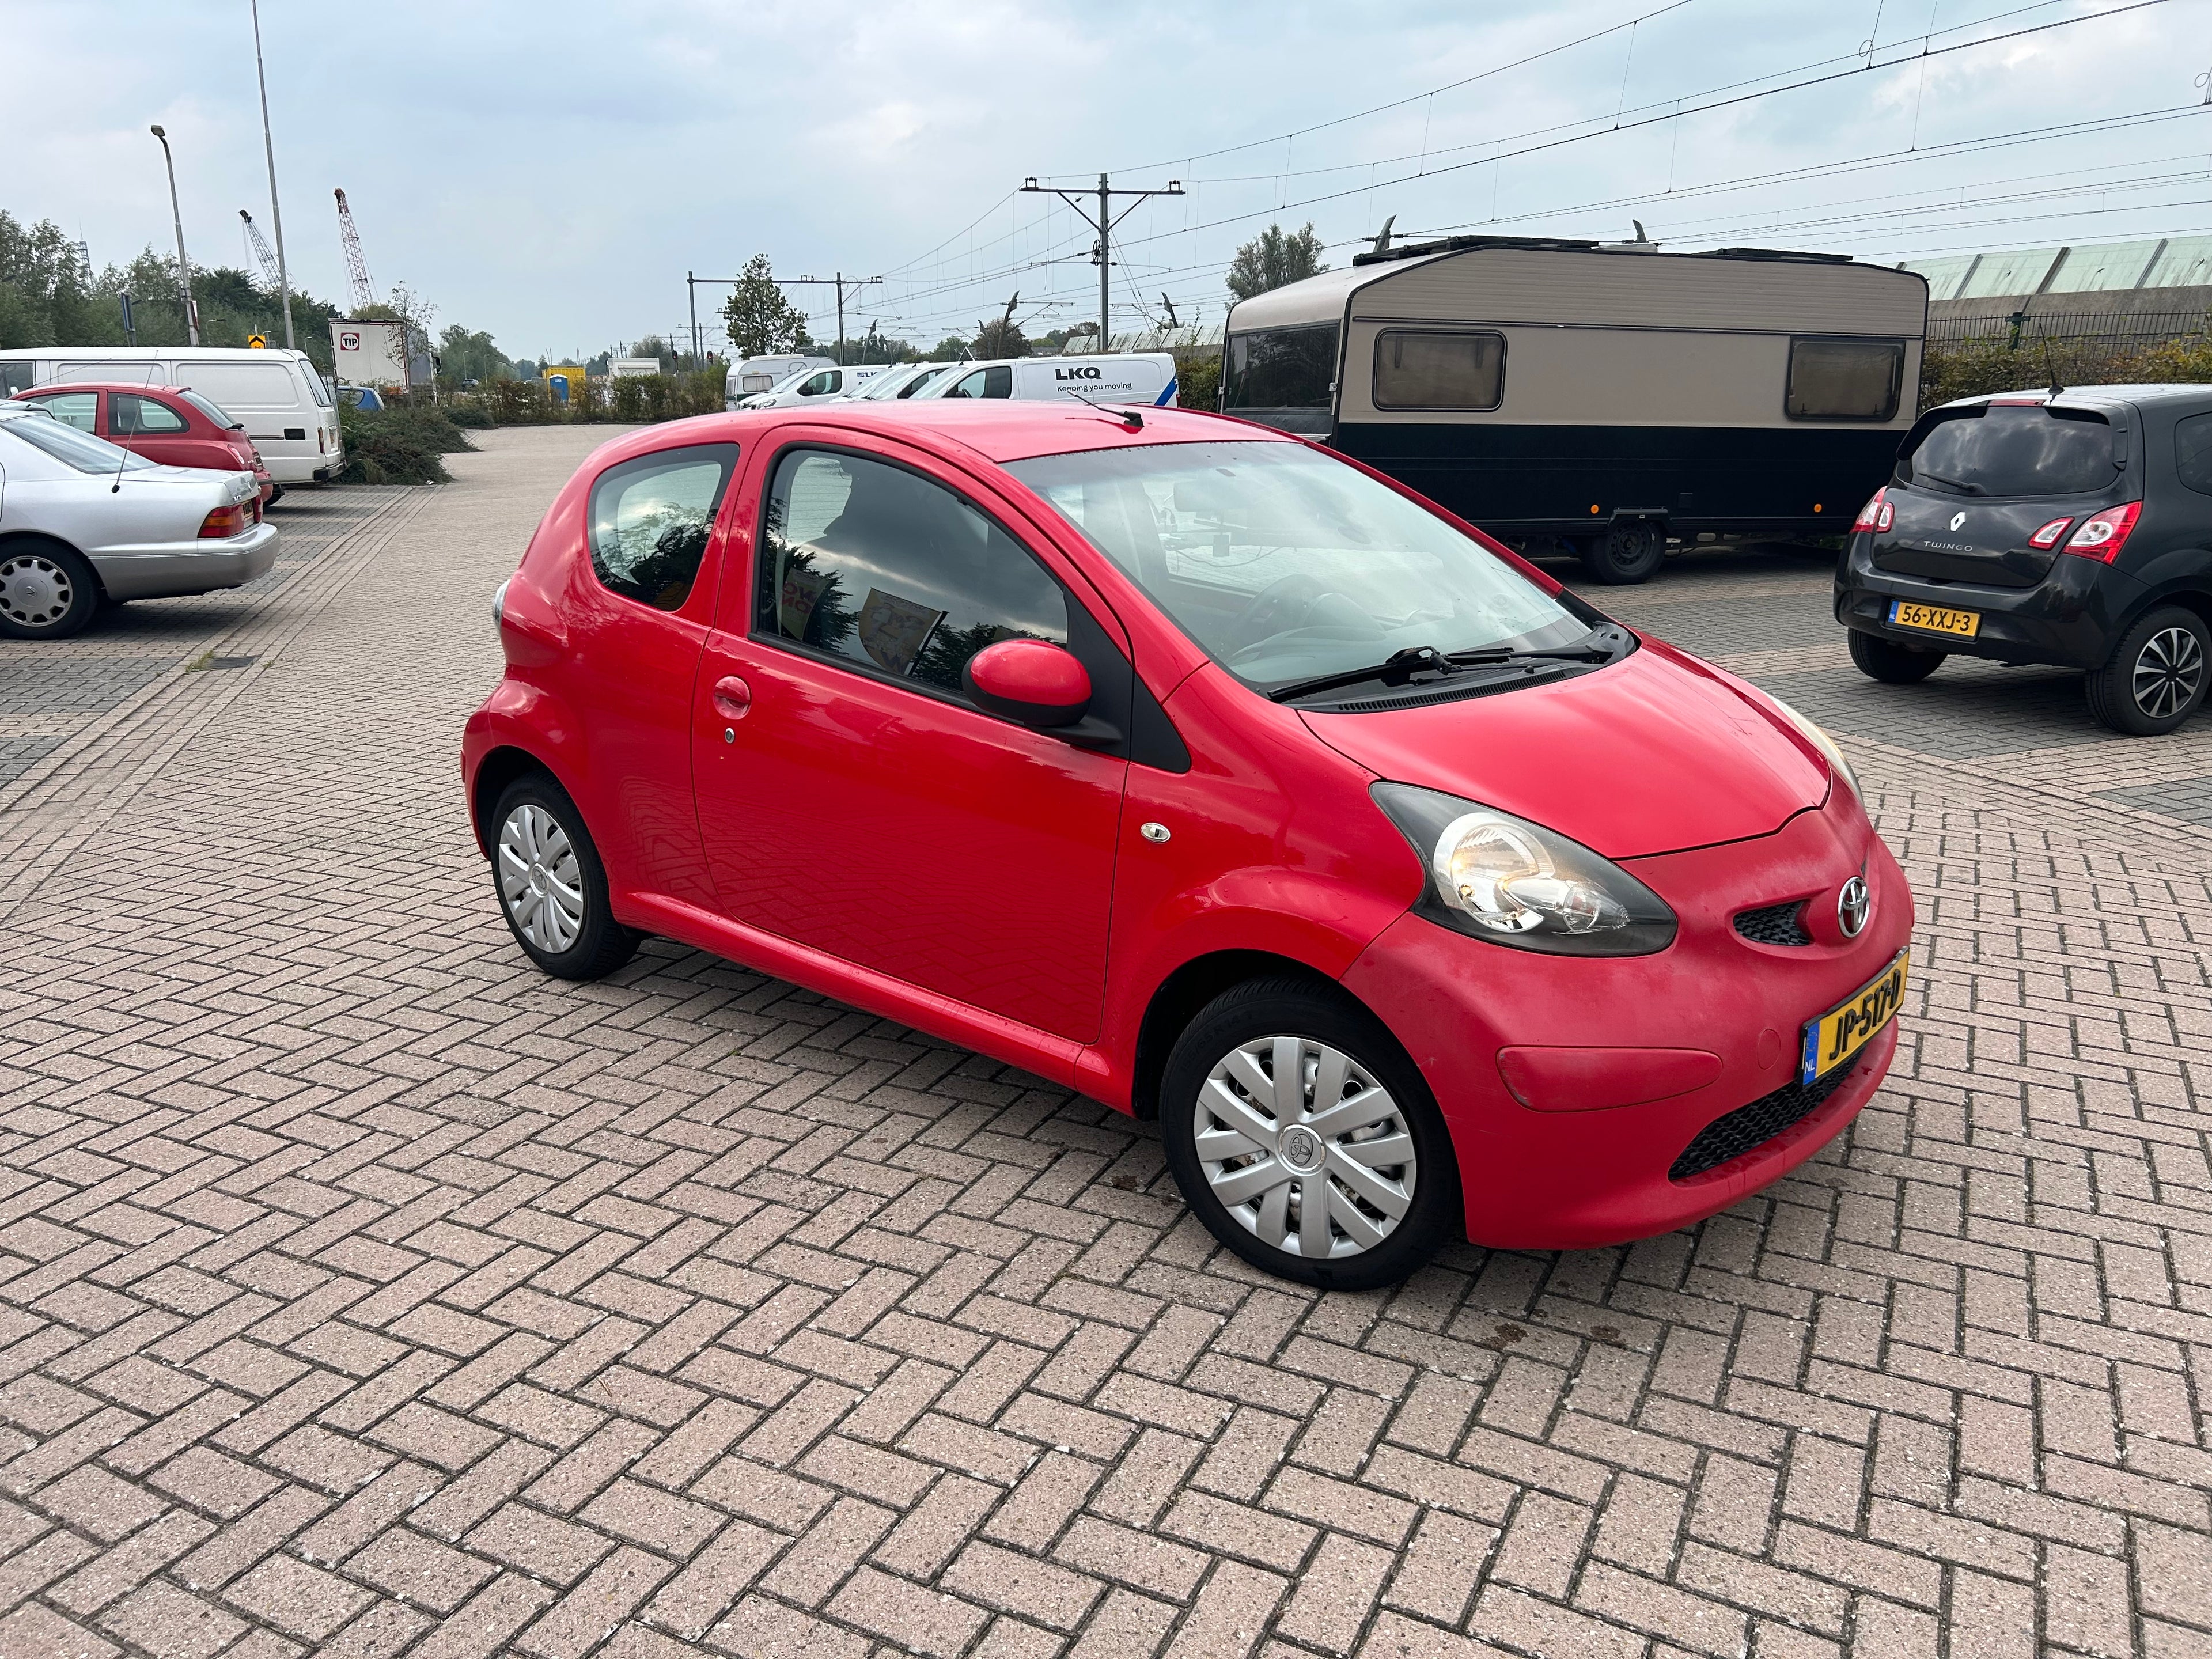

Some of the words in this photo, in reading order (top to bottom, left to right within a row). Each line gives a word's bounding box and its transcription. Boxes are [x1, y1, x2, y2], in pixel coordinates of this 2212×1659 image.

[343, 338, 358, 346] TIP
[1055, 367, 1102, 380] LKQ
[1057, 384, 1088, 392] Keeping
[1105, 382, 1132, 391] moving
[1924, 541, 1973, 551] TWINGO
[1902, 605, 1971, 632] 56-XXJ-3
[1829, 969, 1900, 1060] JP-517-D
[1805, 1059, 1815, 1074] NL
